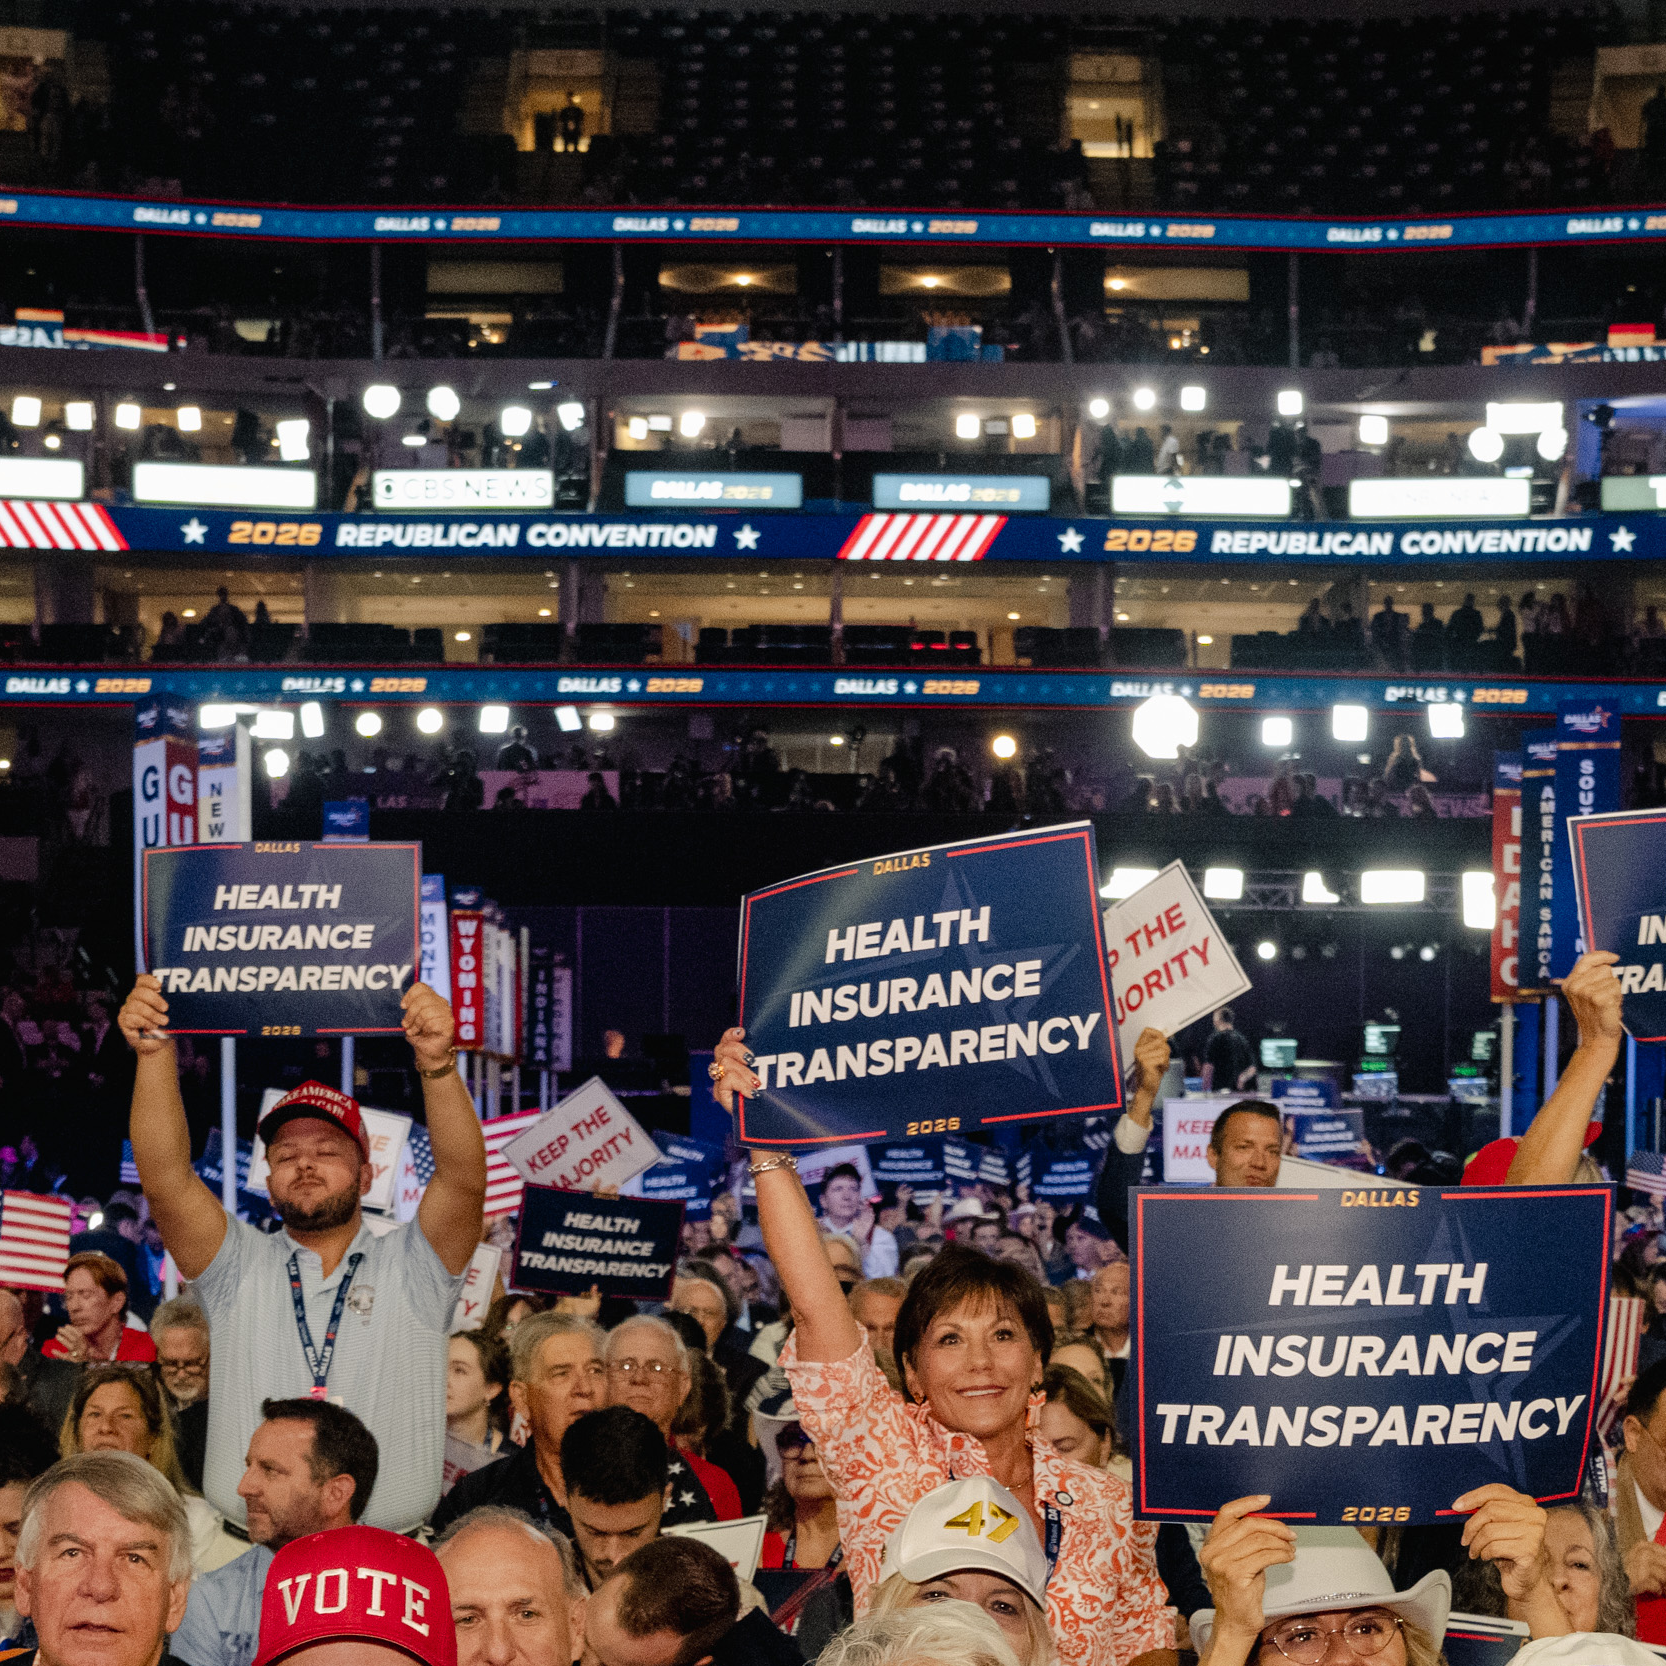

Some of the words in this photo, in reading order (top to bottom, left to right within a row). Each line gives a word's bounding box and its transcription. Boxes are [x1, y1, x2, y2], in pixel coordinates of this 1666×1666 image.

[403, 478, 453, 500] CBS
[464, 478, 548, 501] NEWS
[228, 521, 322, 545] 2026
[336, 524, 520, 547] REPUBLICAN
[527, 524, 717, 547] CONVENTION
[209, 783, 225, 838] NEW
[254, 842, 300, 854] DALLAS
[1537, 784, 1556, 900] AMERICAN
[873, 853, 931, 875] DALLAS
[214, 883, 341, 911] HEALTH
[182, 924, 374, 952] INSURANCE
[825, 906, 991, 964] HEALTH
[1126, 902, 1187, 956] THE
[1536, 905, 1555, 979] SAMOA
[151, 965, 411, 993] TRANSPARENCY
[456, 915, 477, 1041] WYOMING
[789, 959, 1042, 1027] INSURANCE
[262, 1026, 302, 1036] 2026
[754, 1012, 1101, 1089] TRANSPARENCY
[525, 1127, 575, 1172] KEEP
[573, 1106, 613, 1142] THE
[907, 1117, 961, 1136] 2026
[1341, 1190, 1420, 1208] DALLAS
[563, 1211, 640, 1234] HEALTH
[541, 1232, 656, 1257] INSURANCE
[519, 1251, 673, 1280] TRANSPARENCY
[1269, 1263, 1488, 1306] HEALTH
[1213, 1330, 1538, 1376] INSURANCE
[1155, 1396, 1586, 1447] TRANSPARENCY
[943, 1499, 1020, 1544] 47
[1341, 1506, 1410, 1522] 2026
[278, 1566, 431, 1638] VOTE
